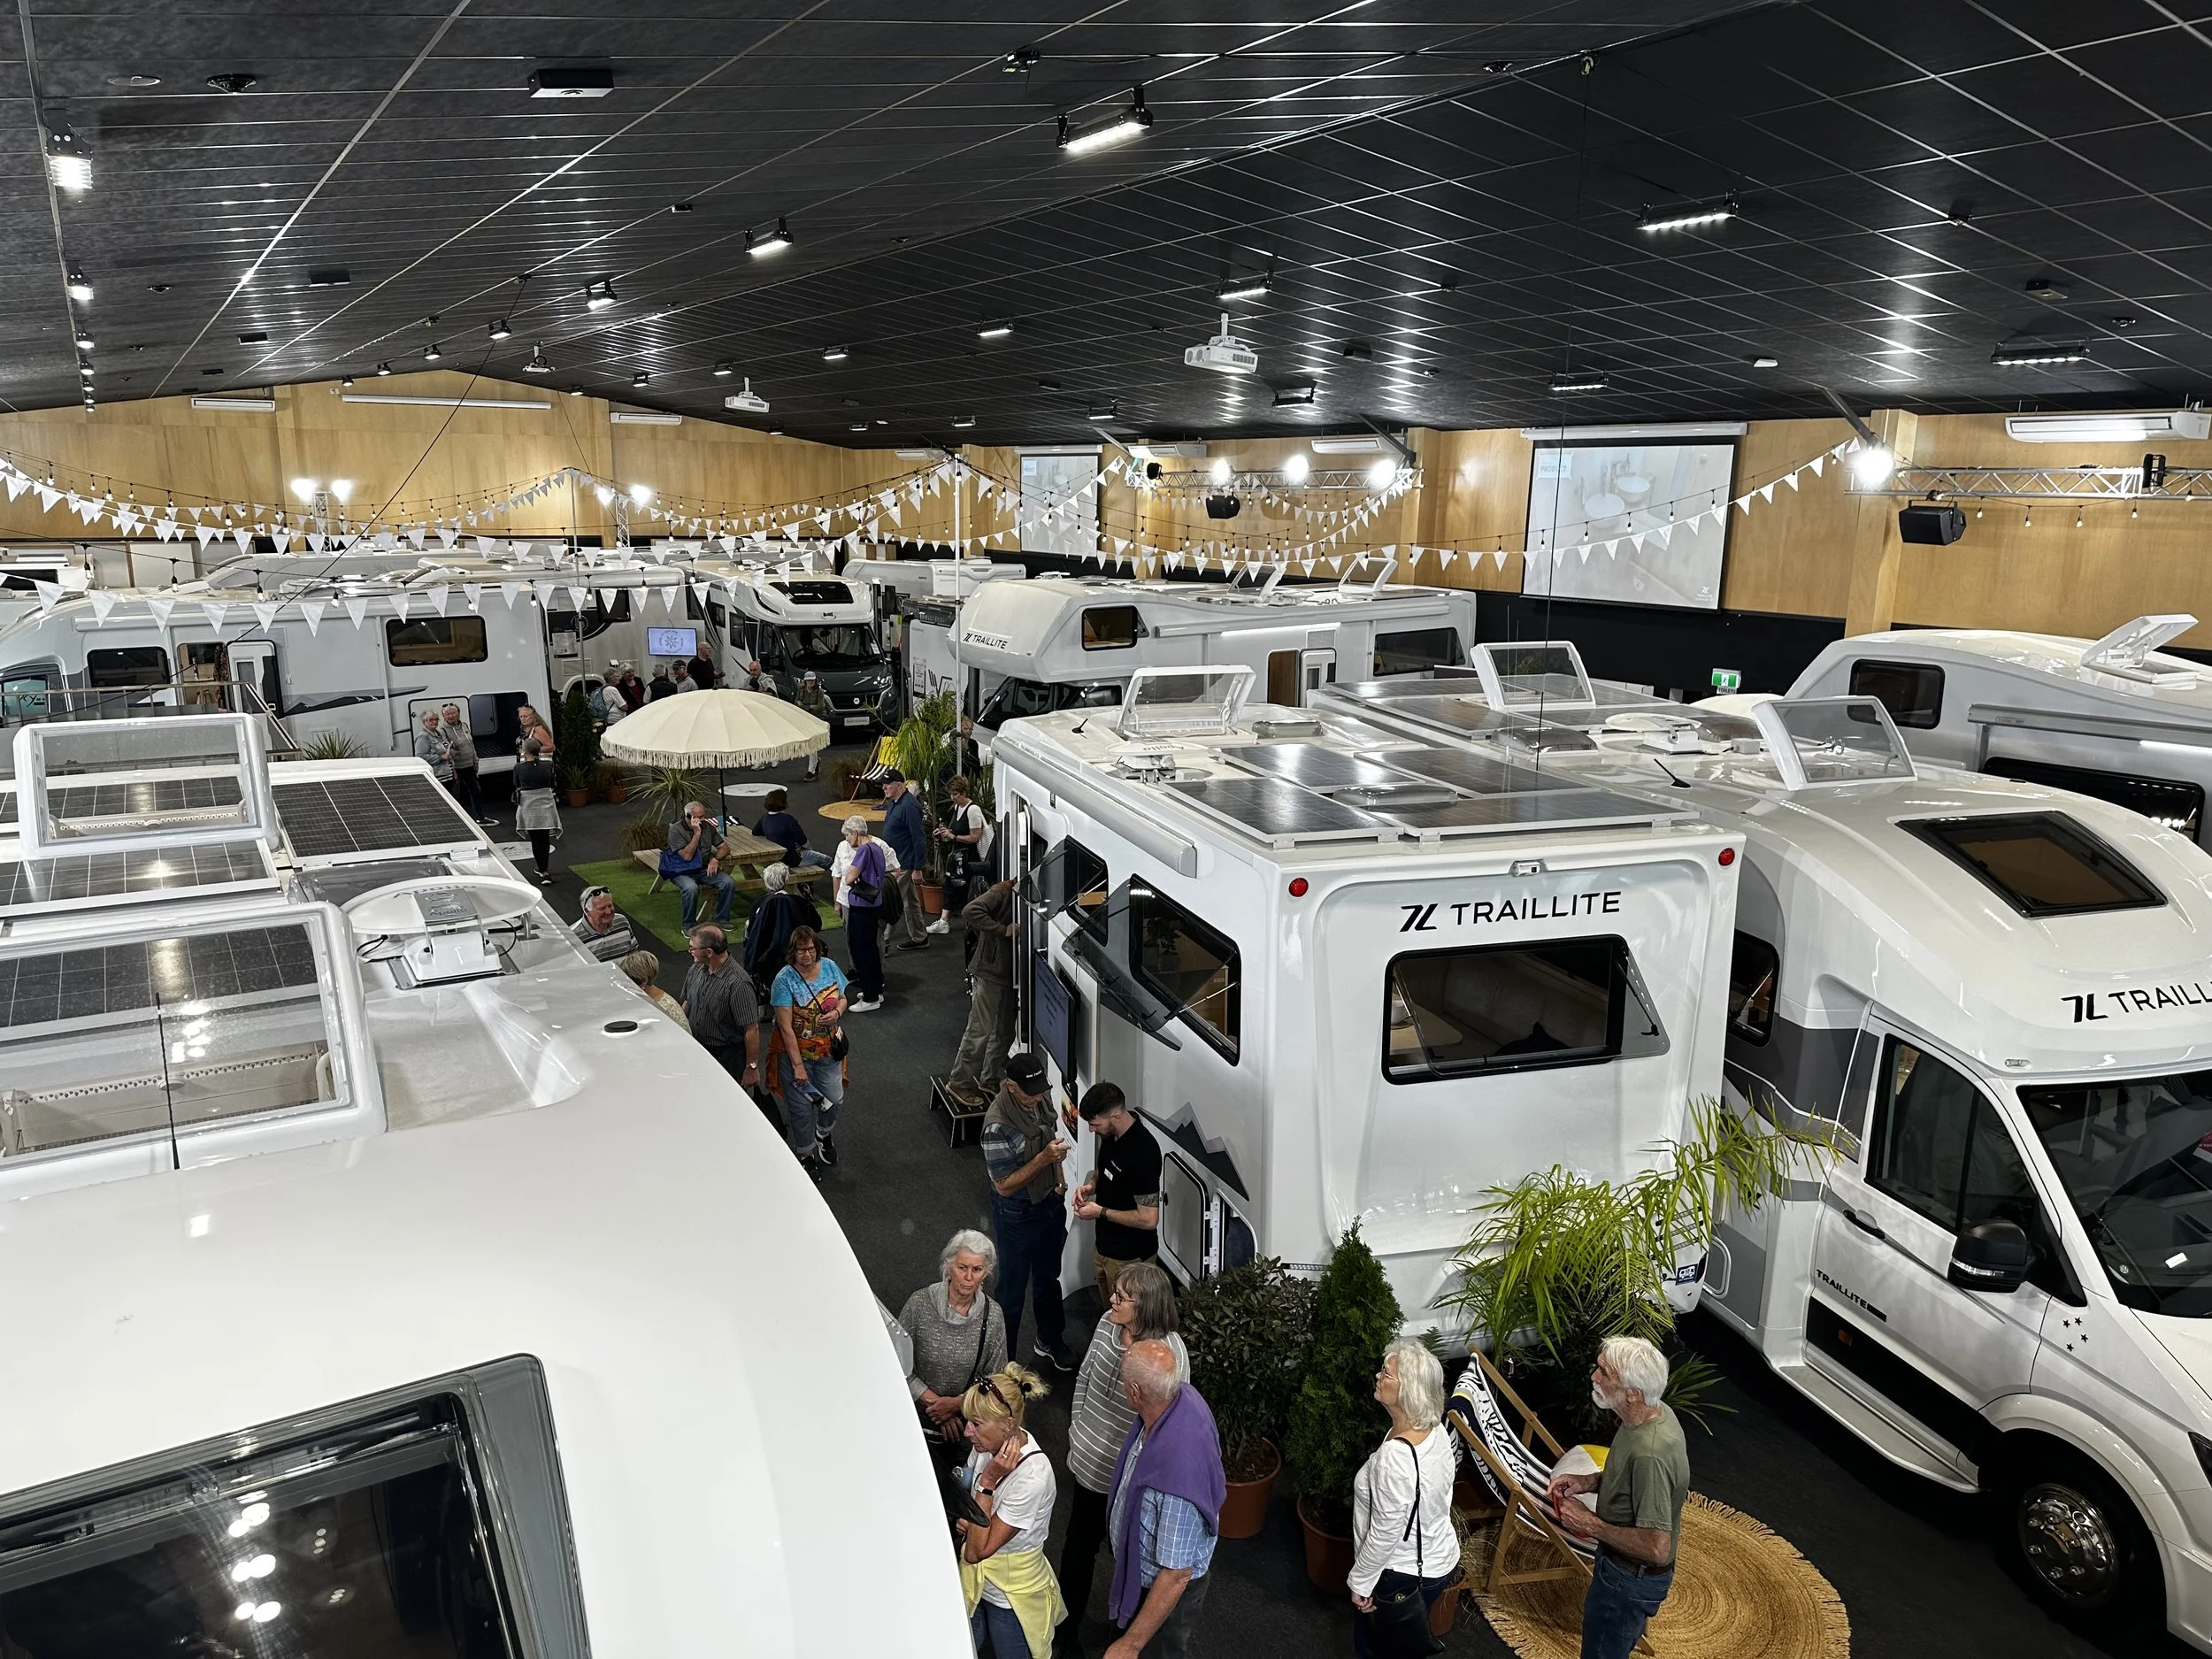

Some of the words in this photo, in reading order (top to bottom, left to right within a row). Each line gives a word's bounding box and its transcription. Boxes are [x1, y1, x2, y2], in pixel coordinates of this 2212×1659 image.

[972, 634, 1009, 649] TRAILLITE
[429, 908, 468, 917] Apollo
[1449, 890, 1622, 926] TRAILLITE
[2108, 980, 2212, 1014] TRAILL
[1816, 1268, 1868, 1310] TRAILLITE
